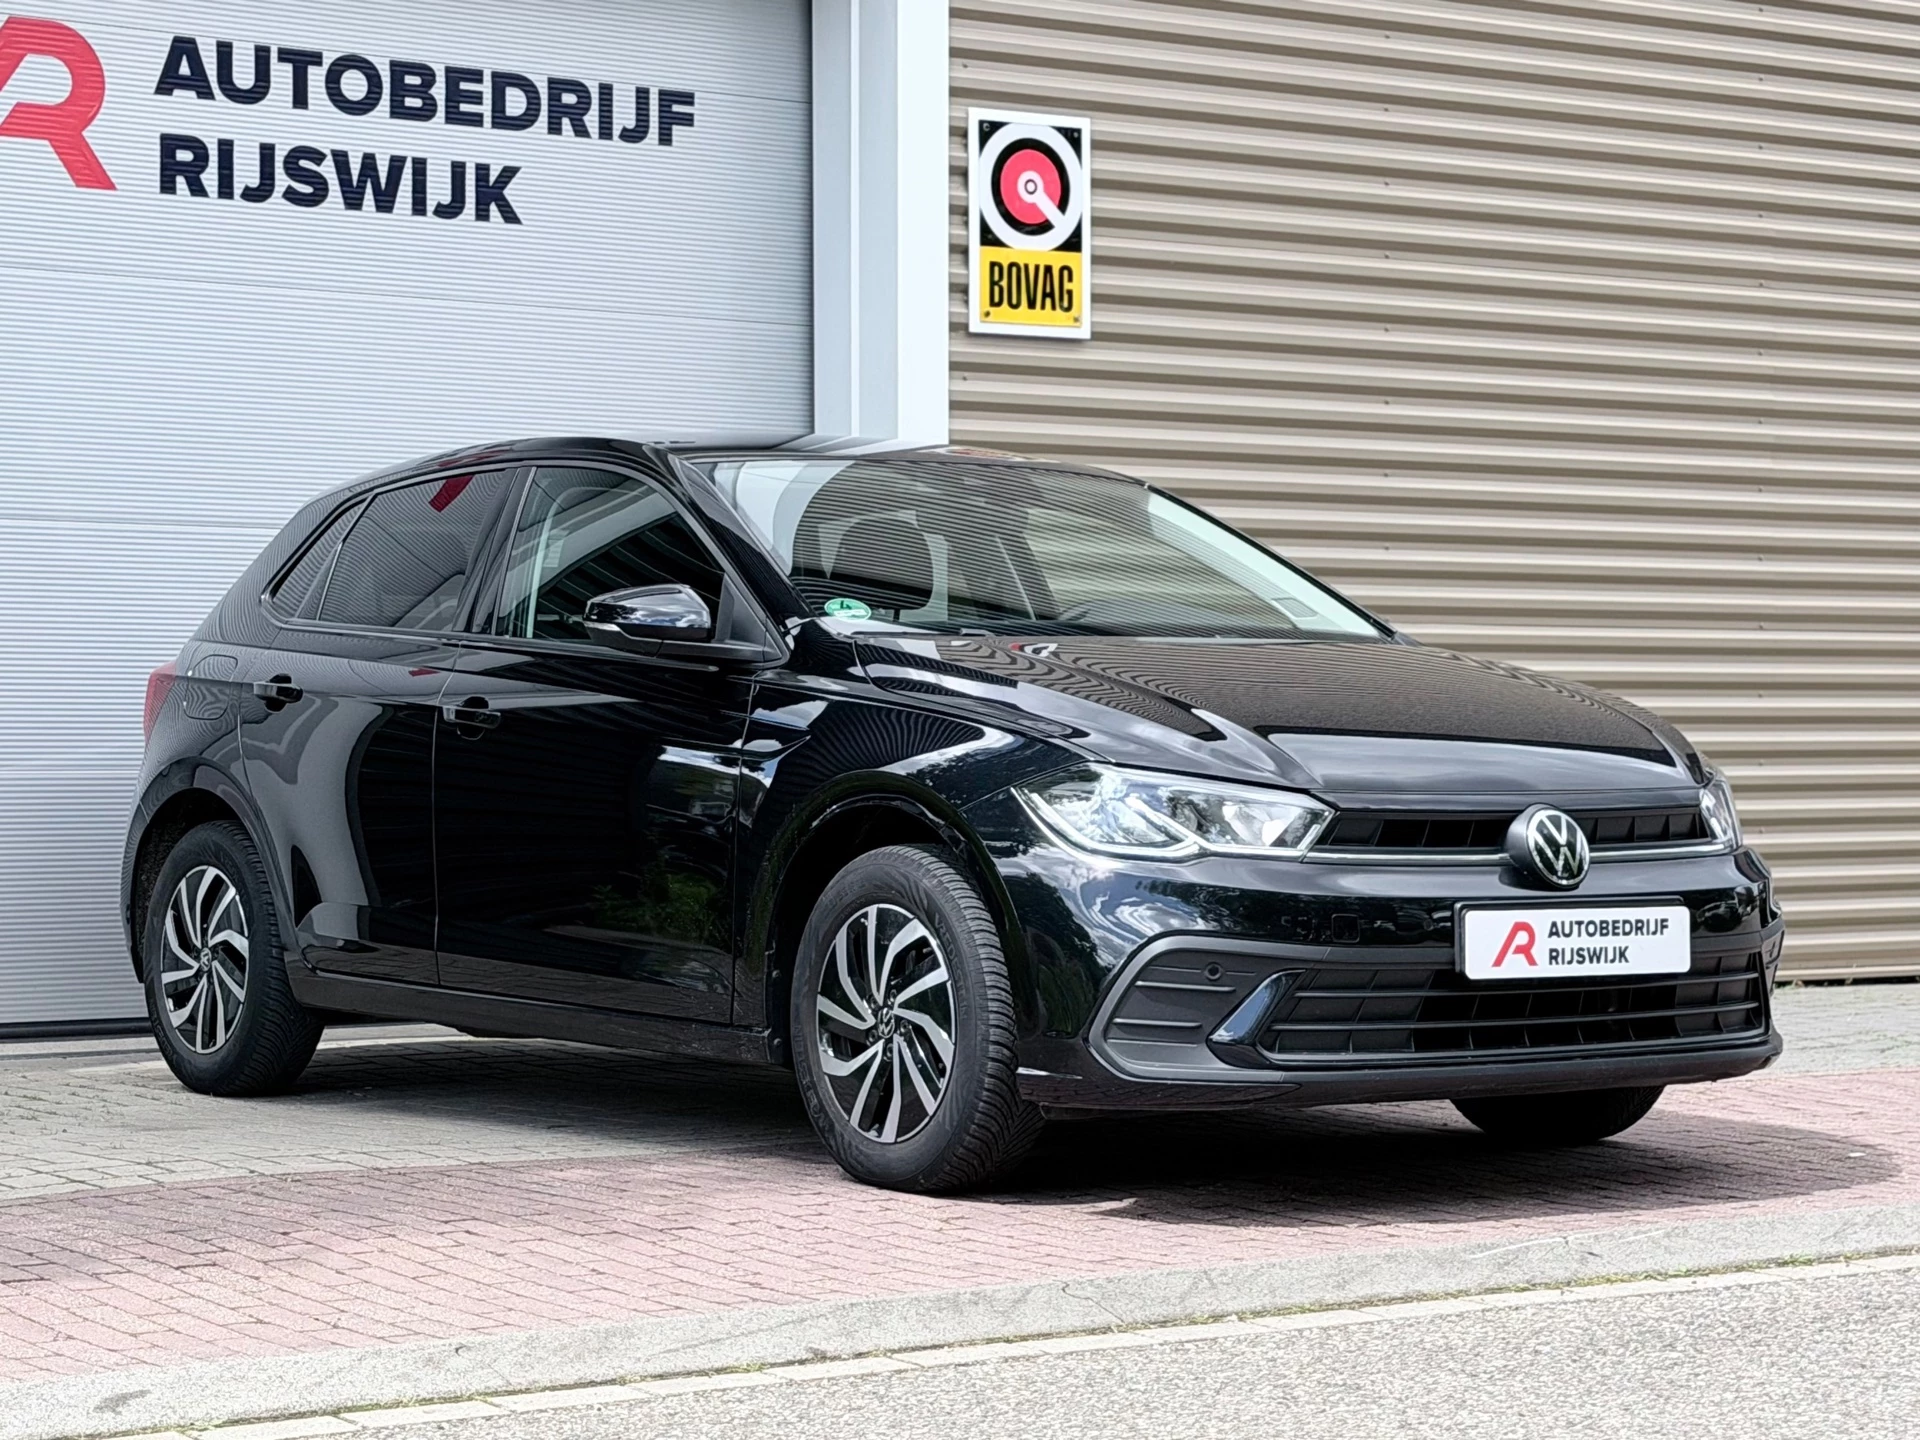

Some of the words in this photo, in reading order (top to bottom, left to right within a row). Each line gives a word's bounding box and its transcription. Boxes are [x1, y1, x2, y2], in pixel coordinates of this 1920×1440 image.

[154, 35, 695, 147] AUTOBEDRIJF
[159, 133, 523, 225] RIJSWIJK
[989, 260, 1074, 313] BOVAG
[1547, 918, 1669, 938] AUTOBEDRIJF
[1549, 946, 1629, 965] RIJSWIJK
